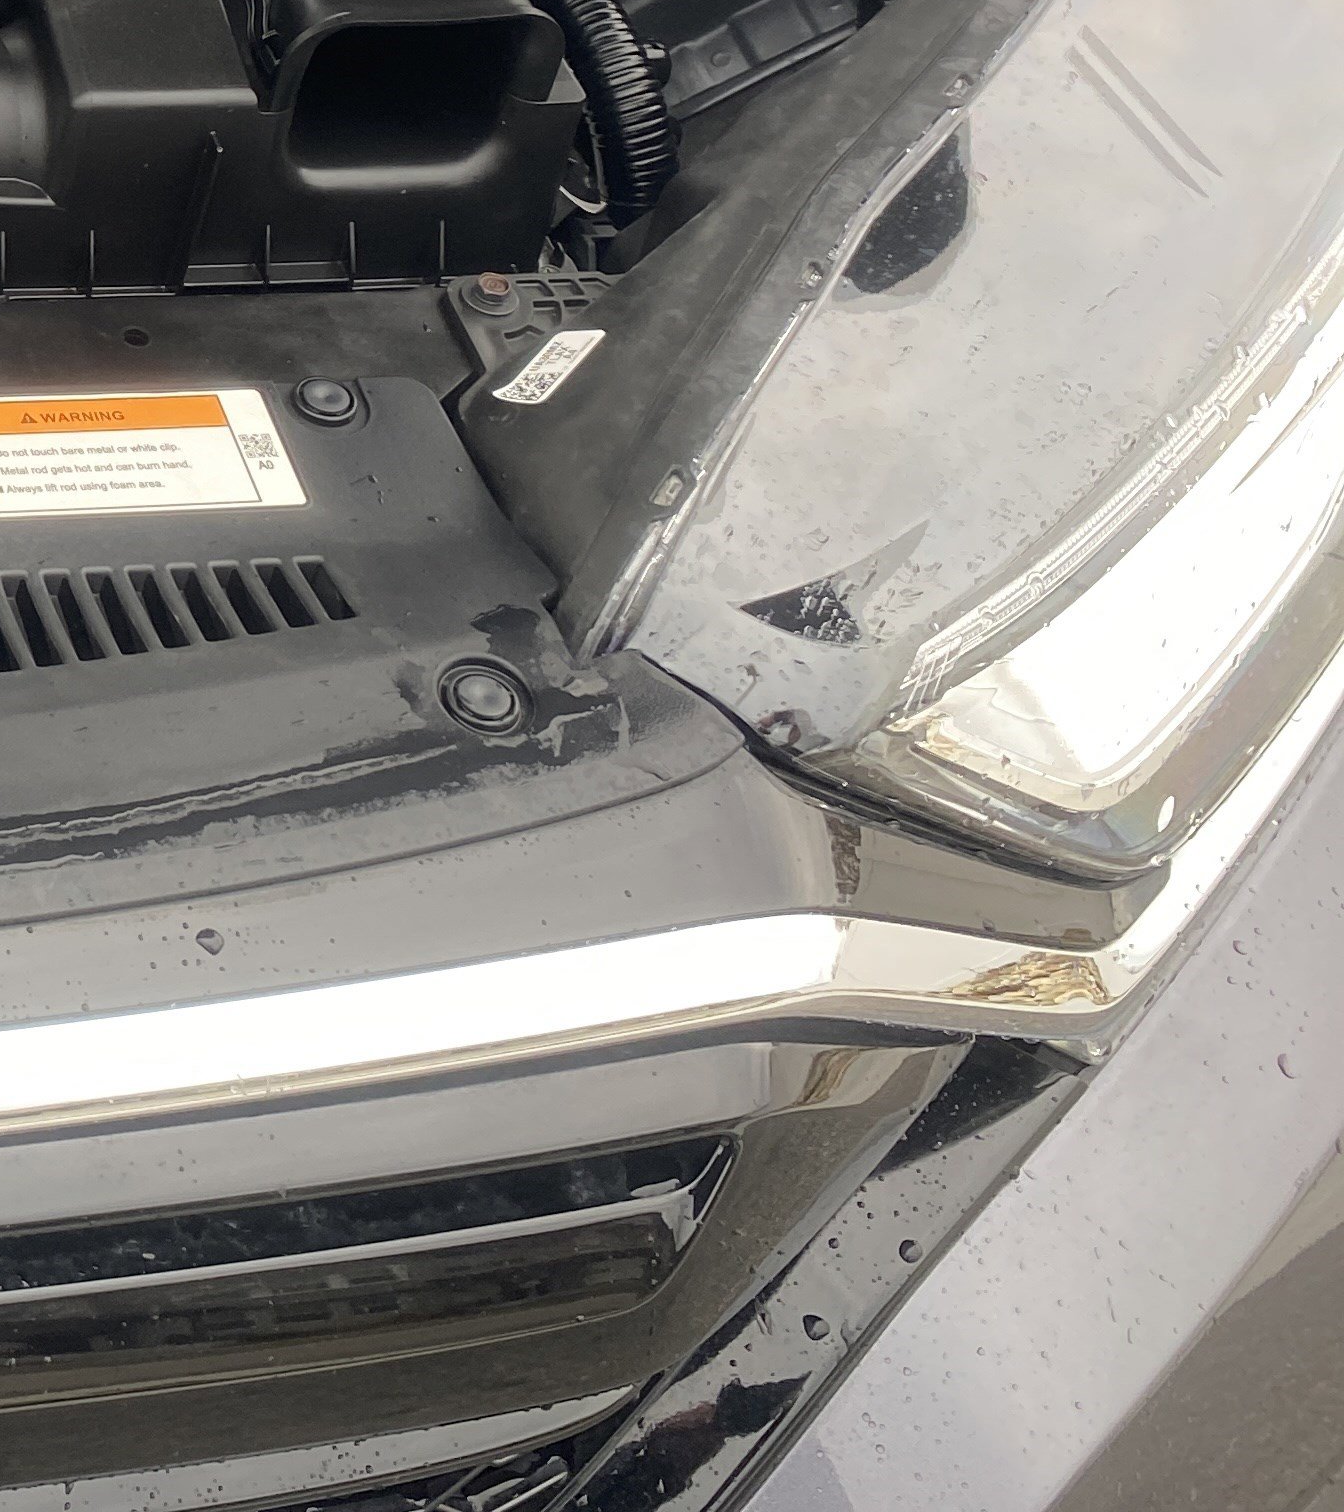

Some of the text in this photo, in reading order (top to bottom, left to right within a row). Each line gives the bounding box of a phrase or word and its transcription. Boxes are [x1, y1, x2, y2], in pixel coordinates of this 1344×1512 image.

[39, 410, 125, 424] WARNING
[12, 448, 30, 457] not
[31, 447, 59, 457] touch
[60, 446, 85, 456] bare
[87, 445, 115, 455] metal
[117, 445, 128, 454] or
[130, 443, 158, 453] white
[159, 442, 182, 453] clip.
[0, 459, 192, 476] Metal rod gets hot and can burn hand.
[6, 479, 166, 495] Always lift rod using foam area.
